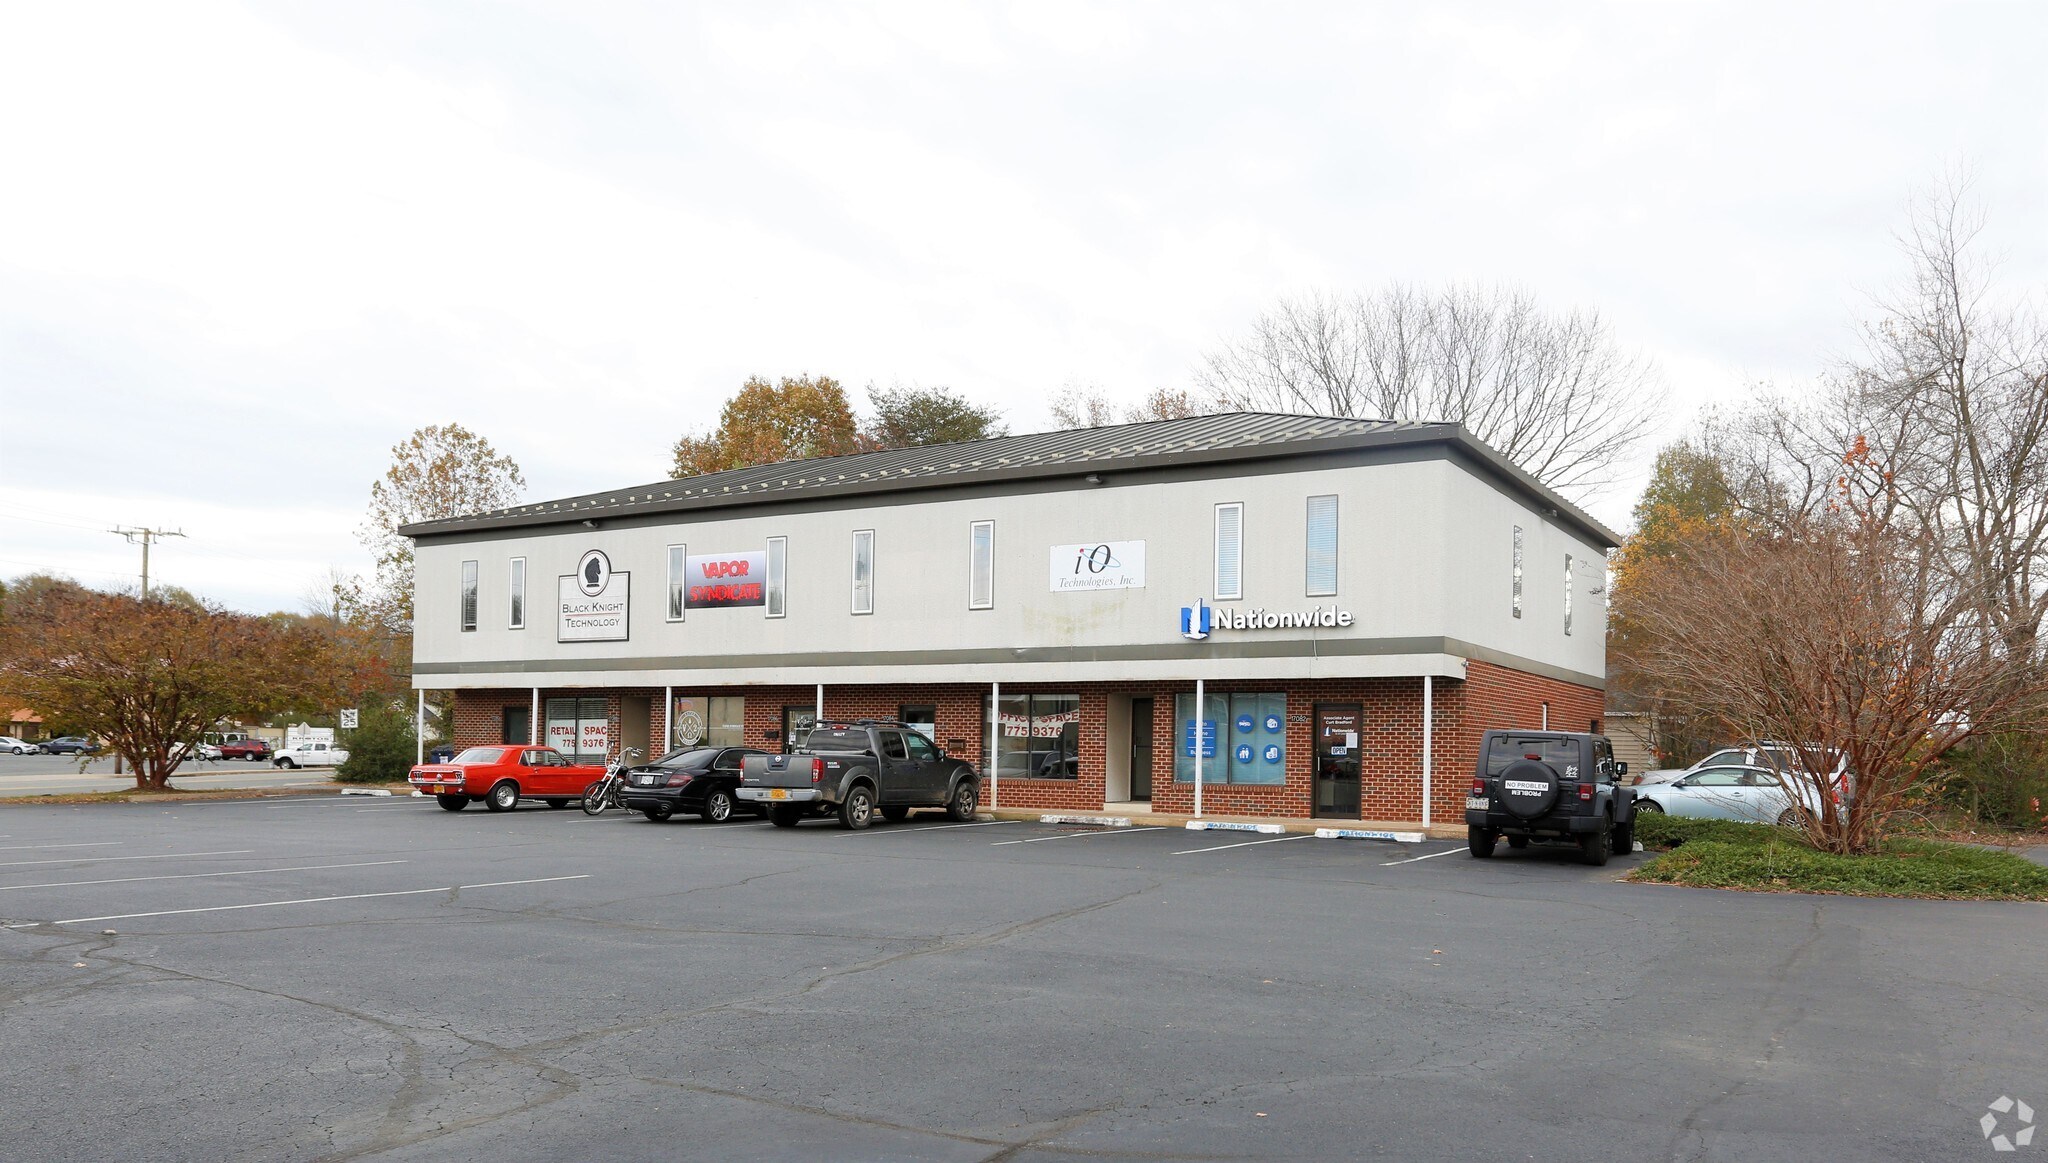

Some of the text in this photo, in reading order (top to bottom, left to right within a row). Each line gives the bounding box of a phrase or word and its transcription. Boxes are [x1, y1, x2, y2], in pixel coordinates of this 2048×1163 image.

[701, 560, 749, 578] VAPOR
[1059, 574, 1136, 588] Technologies, Inc.
[689, 582, 762, 602] SYNDICATE
[1214, 604, 1353, 630] Nationwide
[343, 719, 356, 727] 25
[997, 711, 1079, 723] FFIC SPACE
[550, 726, 607, 736] RETAIL SPAC
[1006, 726, 1063, 737] 775 9376
[562, 738, 604, 748] 775 9376
